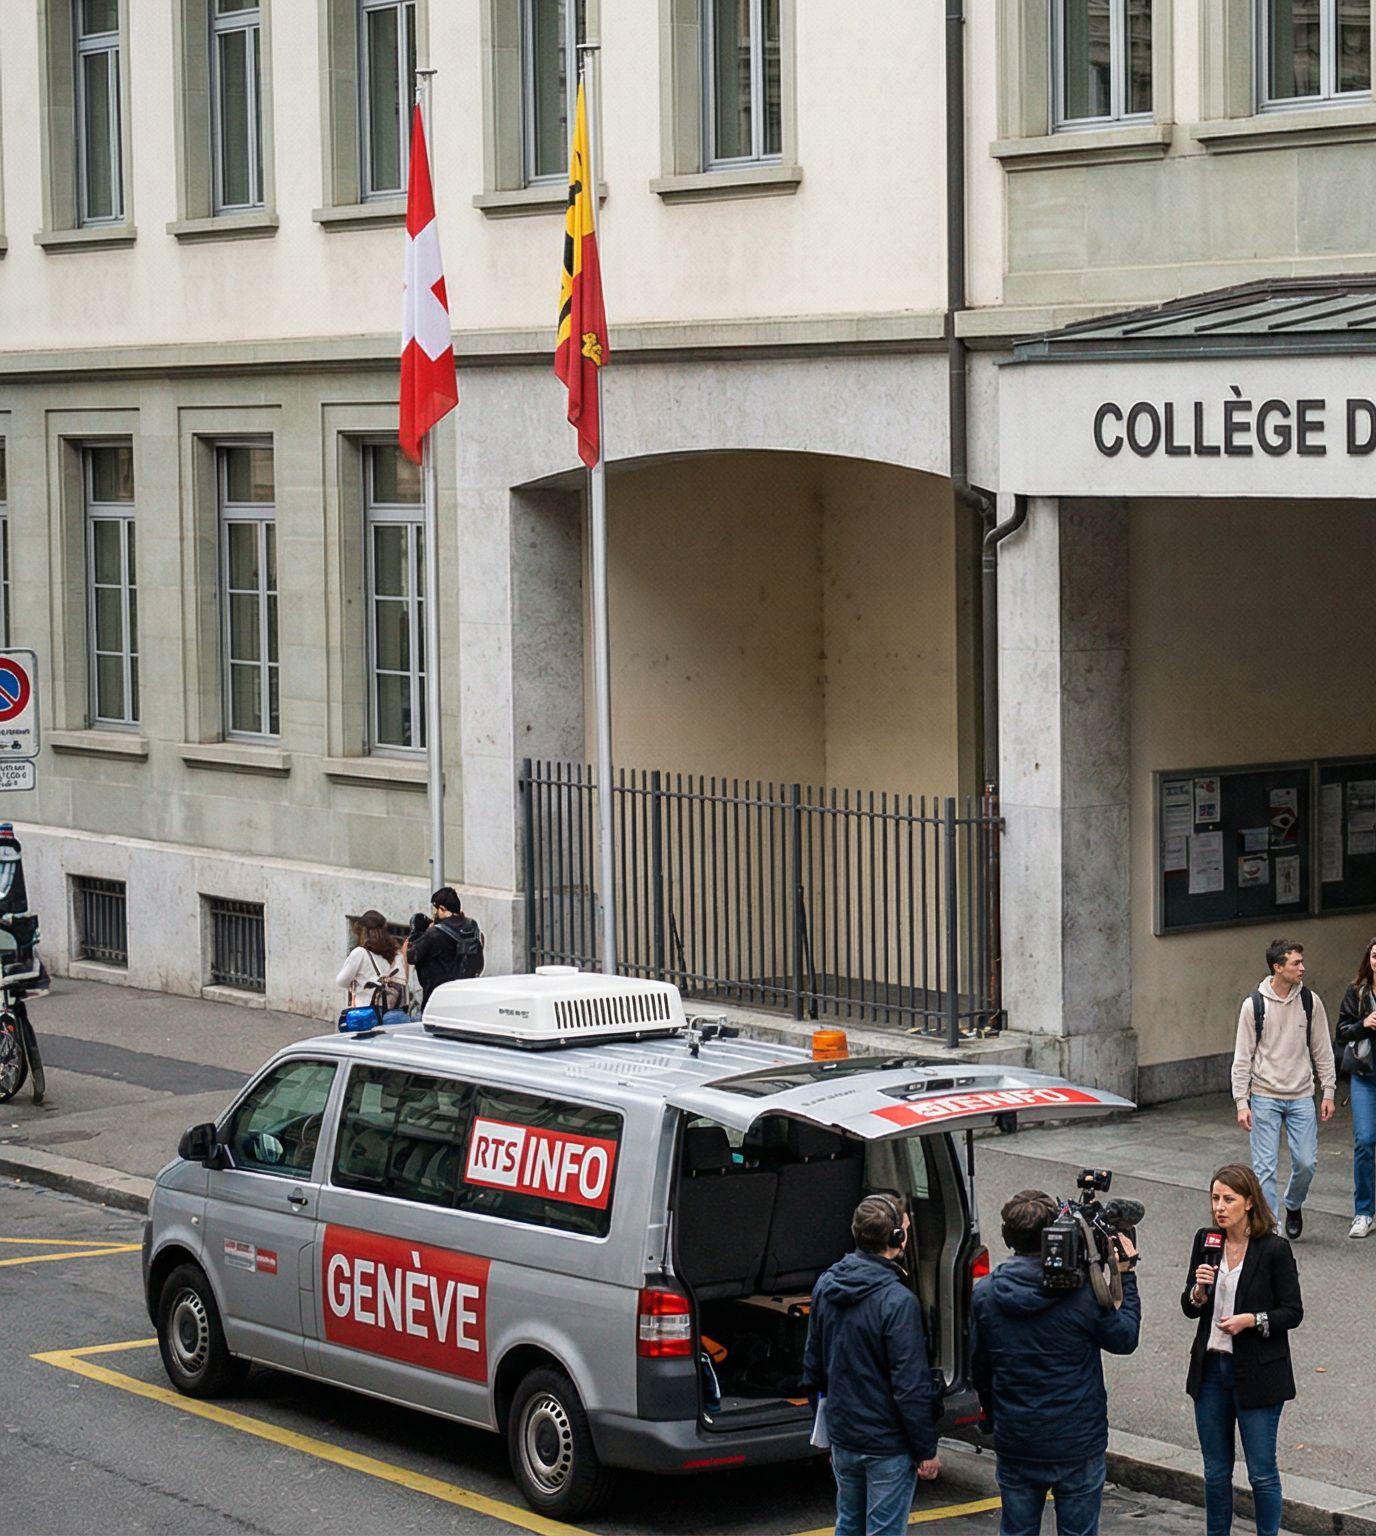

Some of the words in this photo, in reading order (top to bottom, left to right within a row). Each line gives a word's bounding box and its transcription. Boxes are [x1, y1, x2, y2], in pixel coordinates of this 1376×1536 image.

[1093, 385, 1327, 458] COLLÈGE
[473, 1135, 519, 1173] RTS
[522, 1135, 609, 1200] INFO
[326, 1250, 480, 1353] GENÈVE
